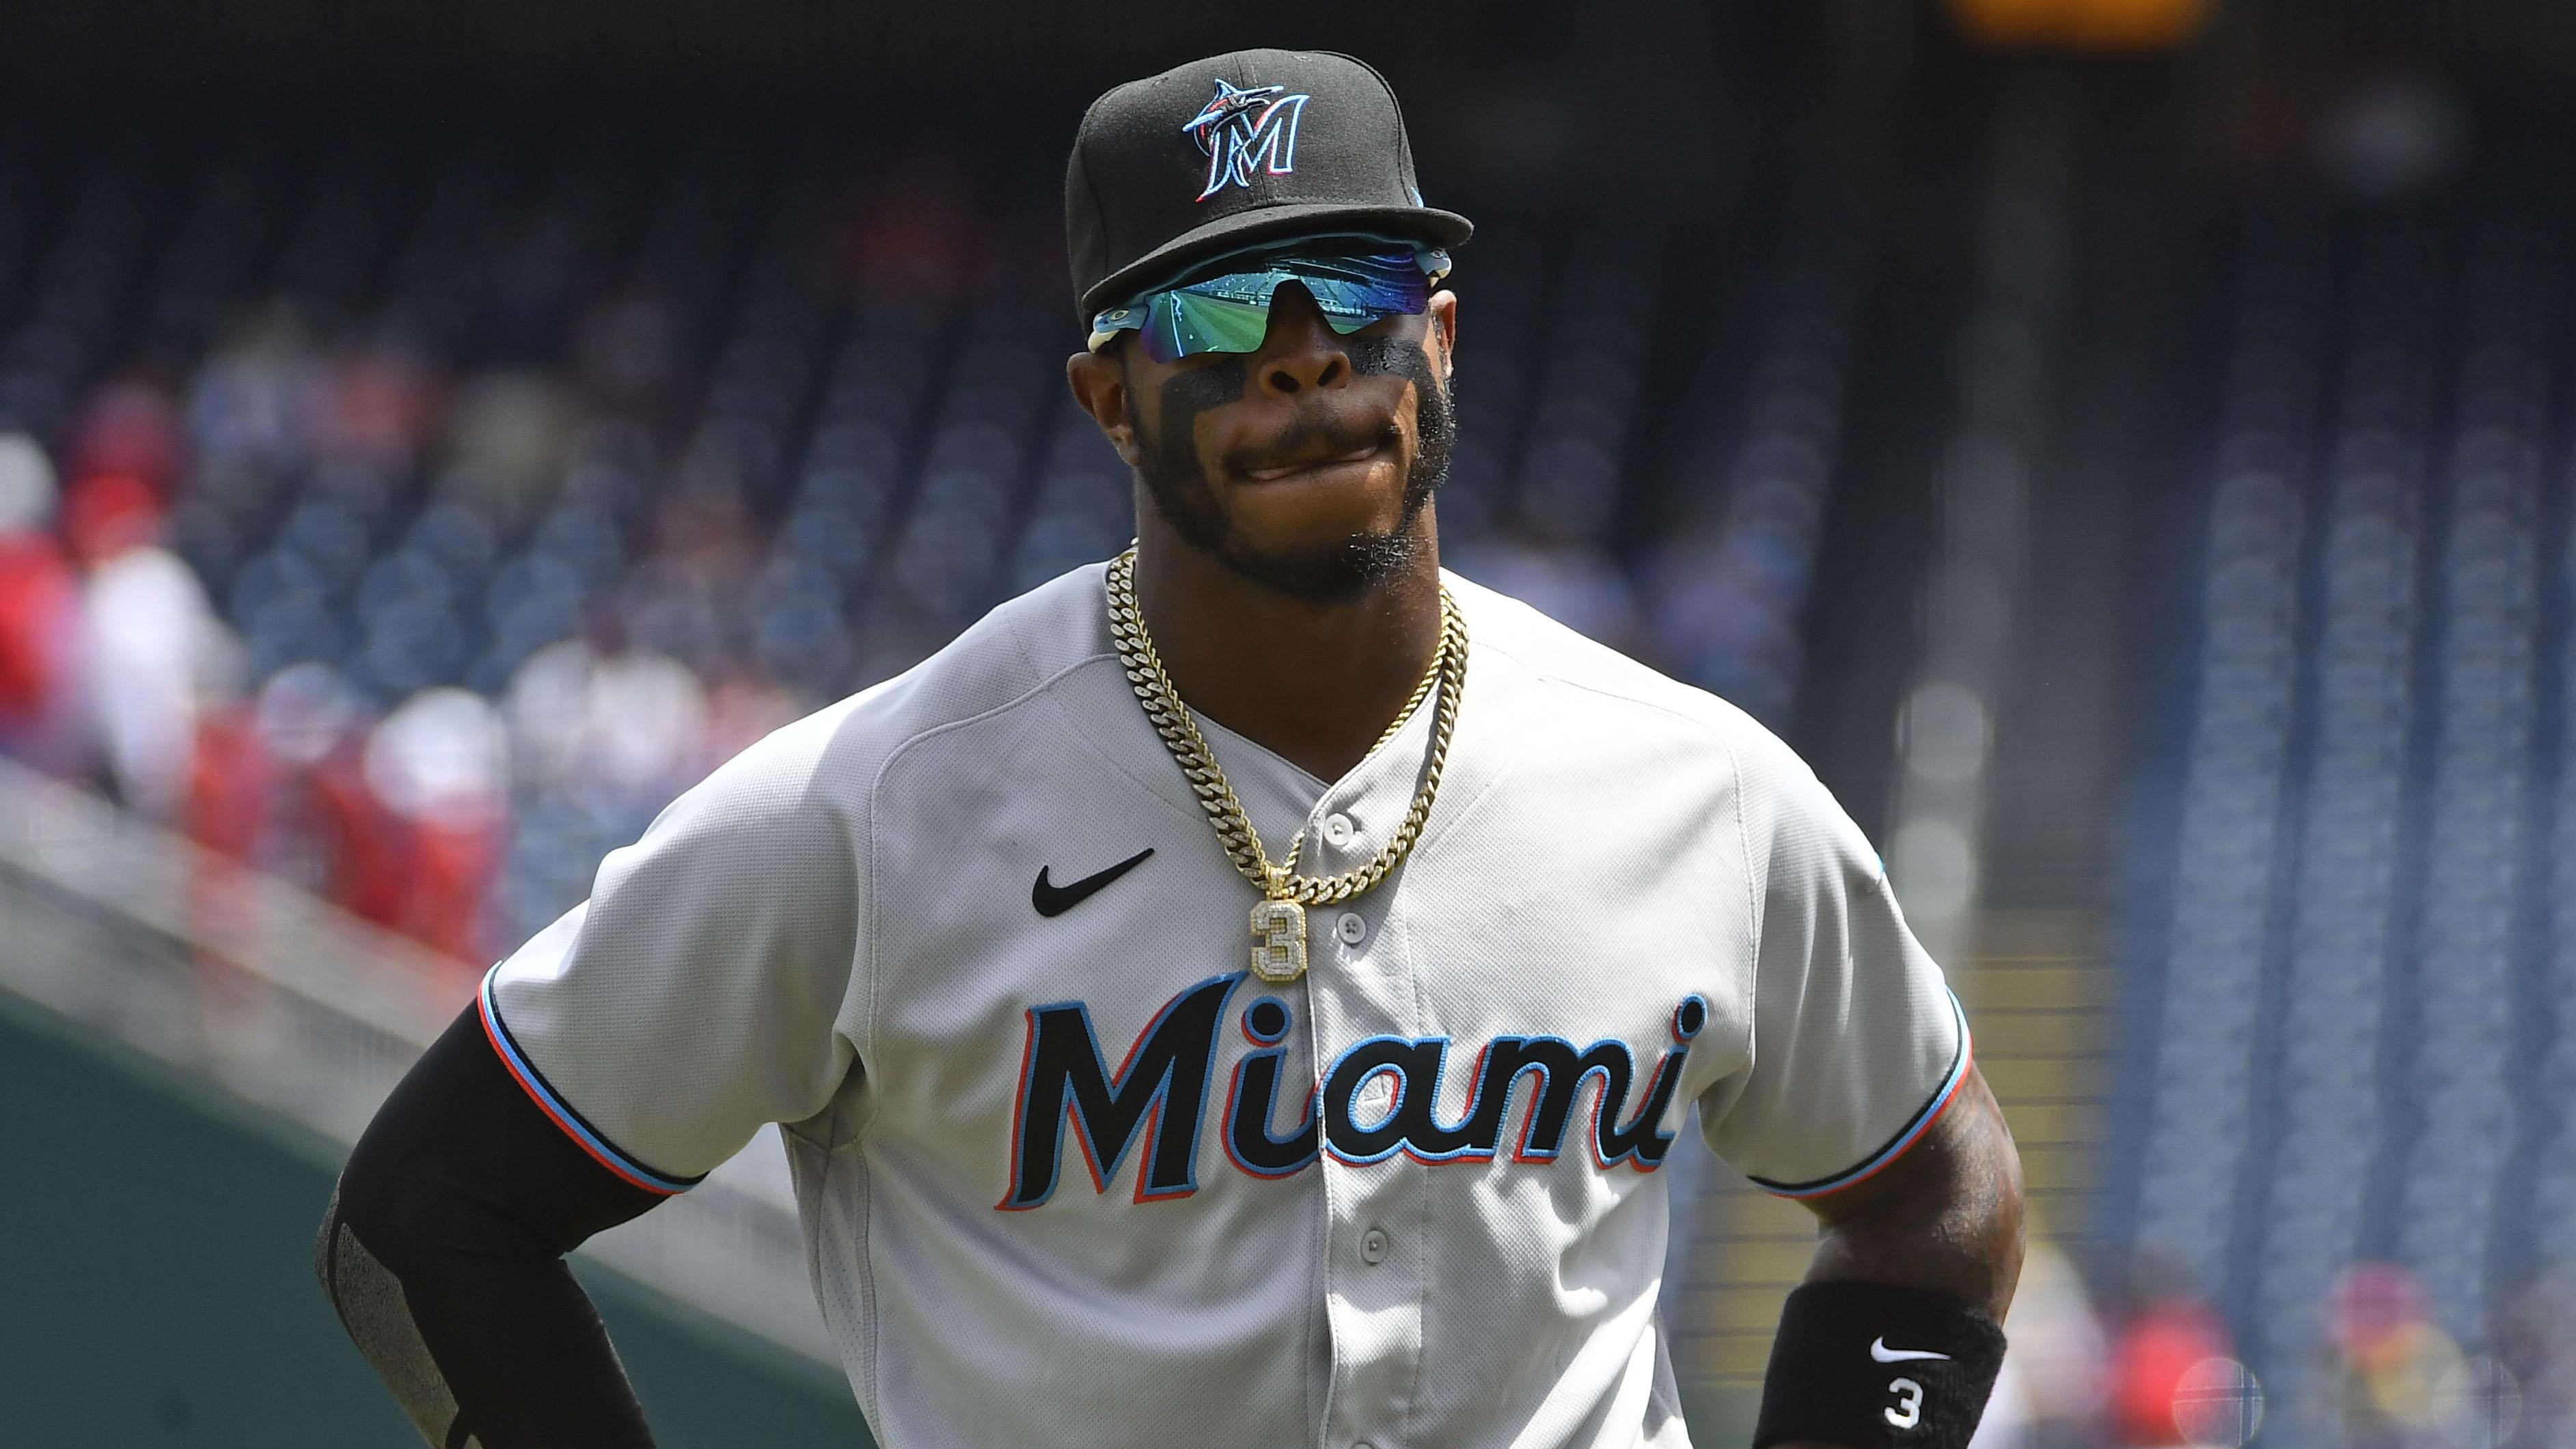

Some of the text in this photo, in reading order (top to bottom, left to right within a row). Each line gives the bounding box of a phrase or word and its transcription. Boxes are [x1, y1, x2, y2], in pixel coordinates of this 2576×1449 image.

[1250, 899, 1308, 981] 3
[994, 970, 1708, 1212] Miami
[1884, 1377, 1923, 1429] 3
